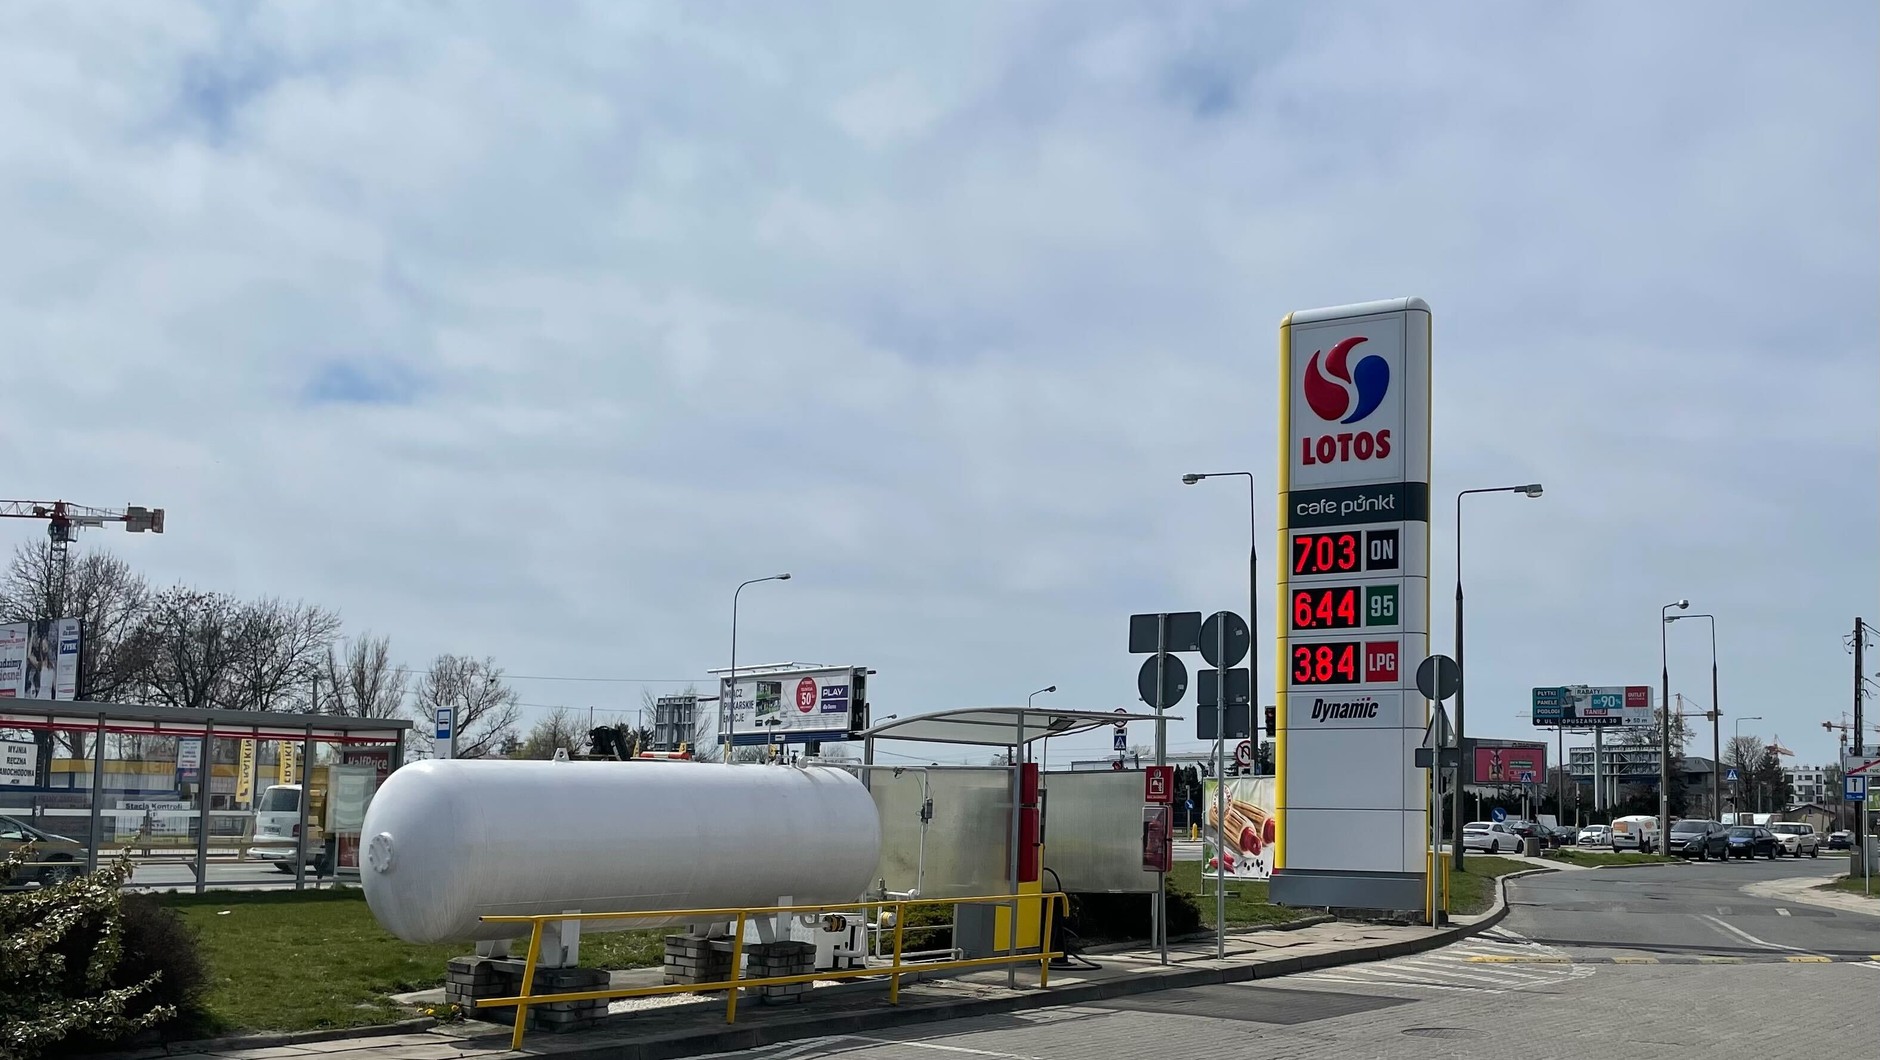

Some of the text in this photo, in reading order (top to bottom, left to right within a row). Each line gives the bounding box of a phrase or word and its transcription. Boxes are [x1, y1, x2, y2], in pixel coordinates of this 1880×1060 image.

[1302, 429, 1391, 466] LOTOS
[1296, 499, 1337, 516] cafe
[1295, 534, 1356, 573] 7.03
[1370, 538, 1394, 561] ON
[1295, 589, 1355, 628] 6.44
[1370, 595, 1394, 617] 95
[1294, 644, 1355, 682] 3.84
[1369, 653, 1395, 672] LPG
[801, 692, 812, 706] 50
[823, 688, 843, 696] PLAY
[1559, 716, 1606, 724] OPUSZAŃSKA
[8, 746, 26, 754] MYJNIA
